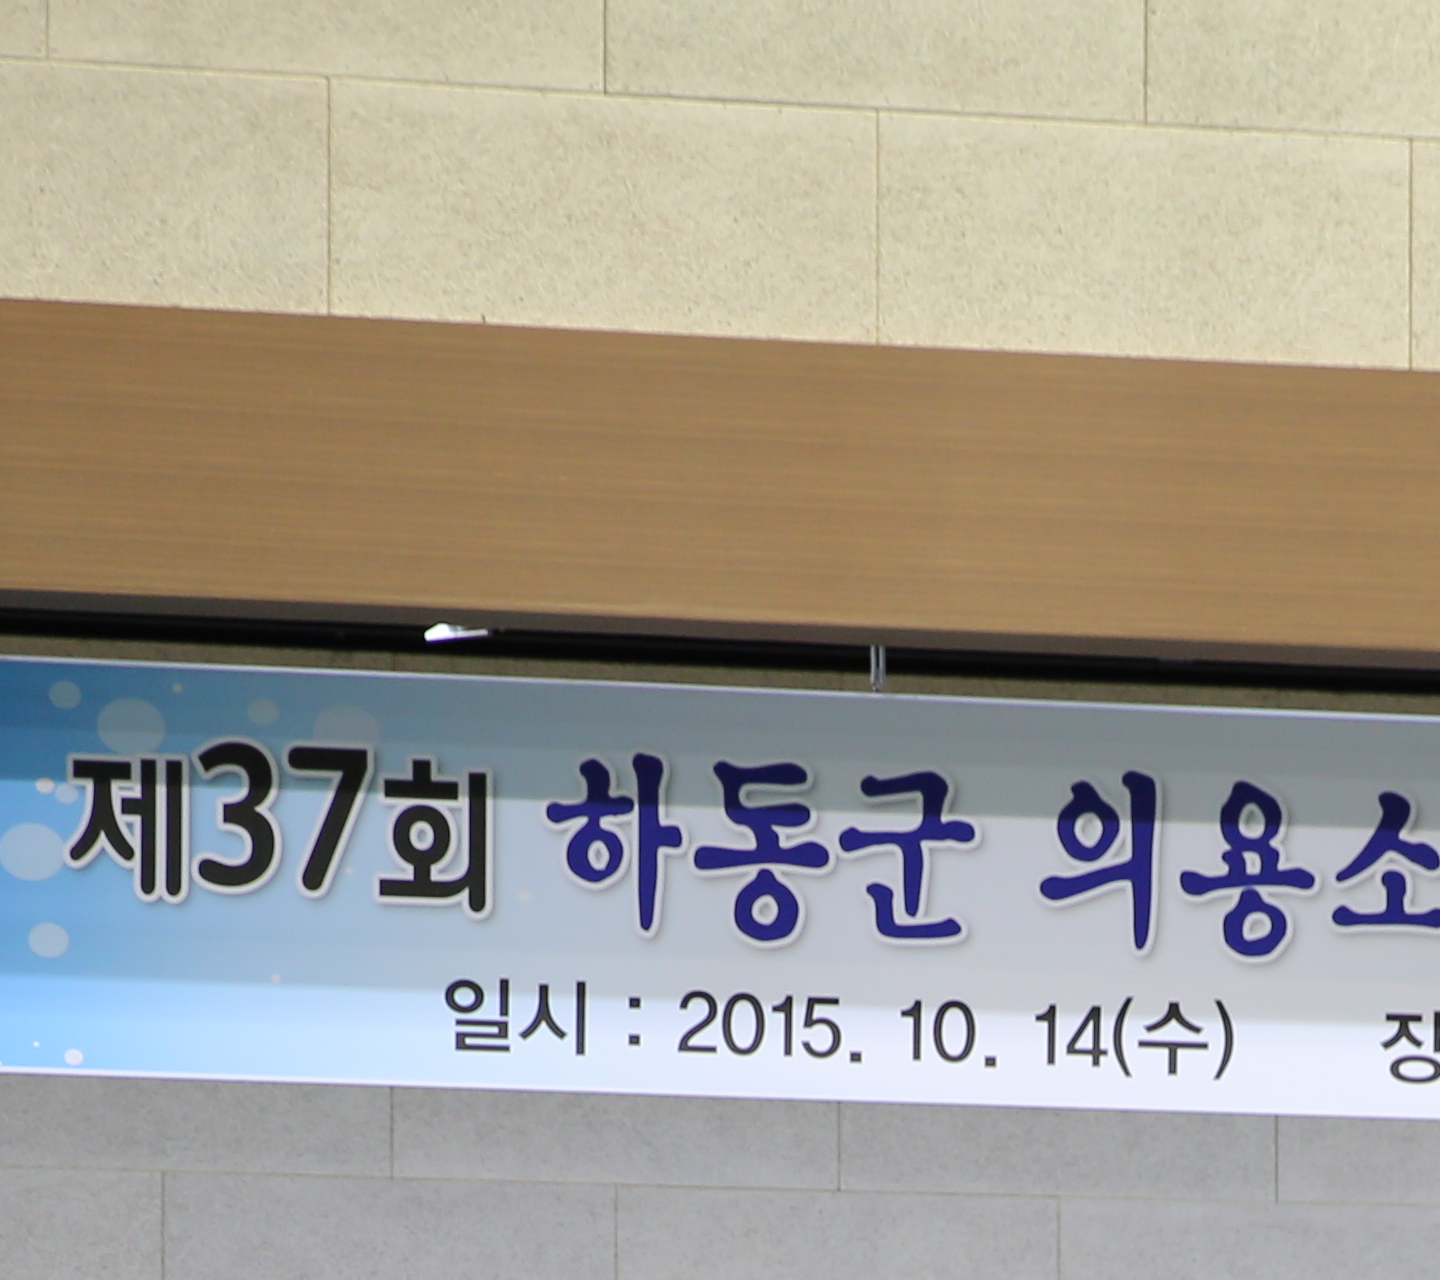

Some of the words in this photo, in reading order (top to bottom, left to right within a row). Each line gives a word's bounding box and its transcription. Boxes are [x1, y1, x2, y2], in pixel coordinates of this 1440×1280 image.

[70, 743, 486, 912] 제37회
[547, 753, 974, 941] 하동군
[445, 979, 585, 1054] 일시
[679, 991, 860, 1061] 2015.
[902, 1001, 995, 1066] 10.
[1036, 998, 1232, 1078] 14(수)
